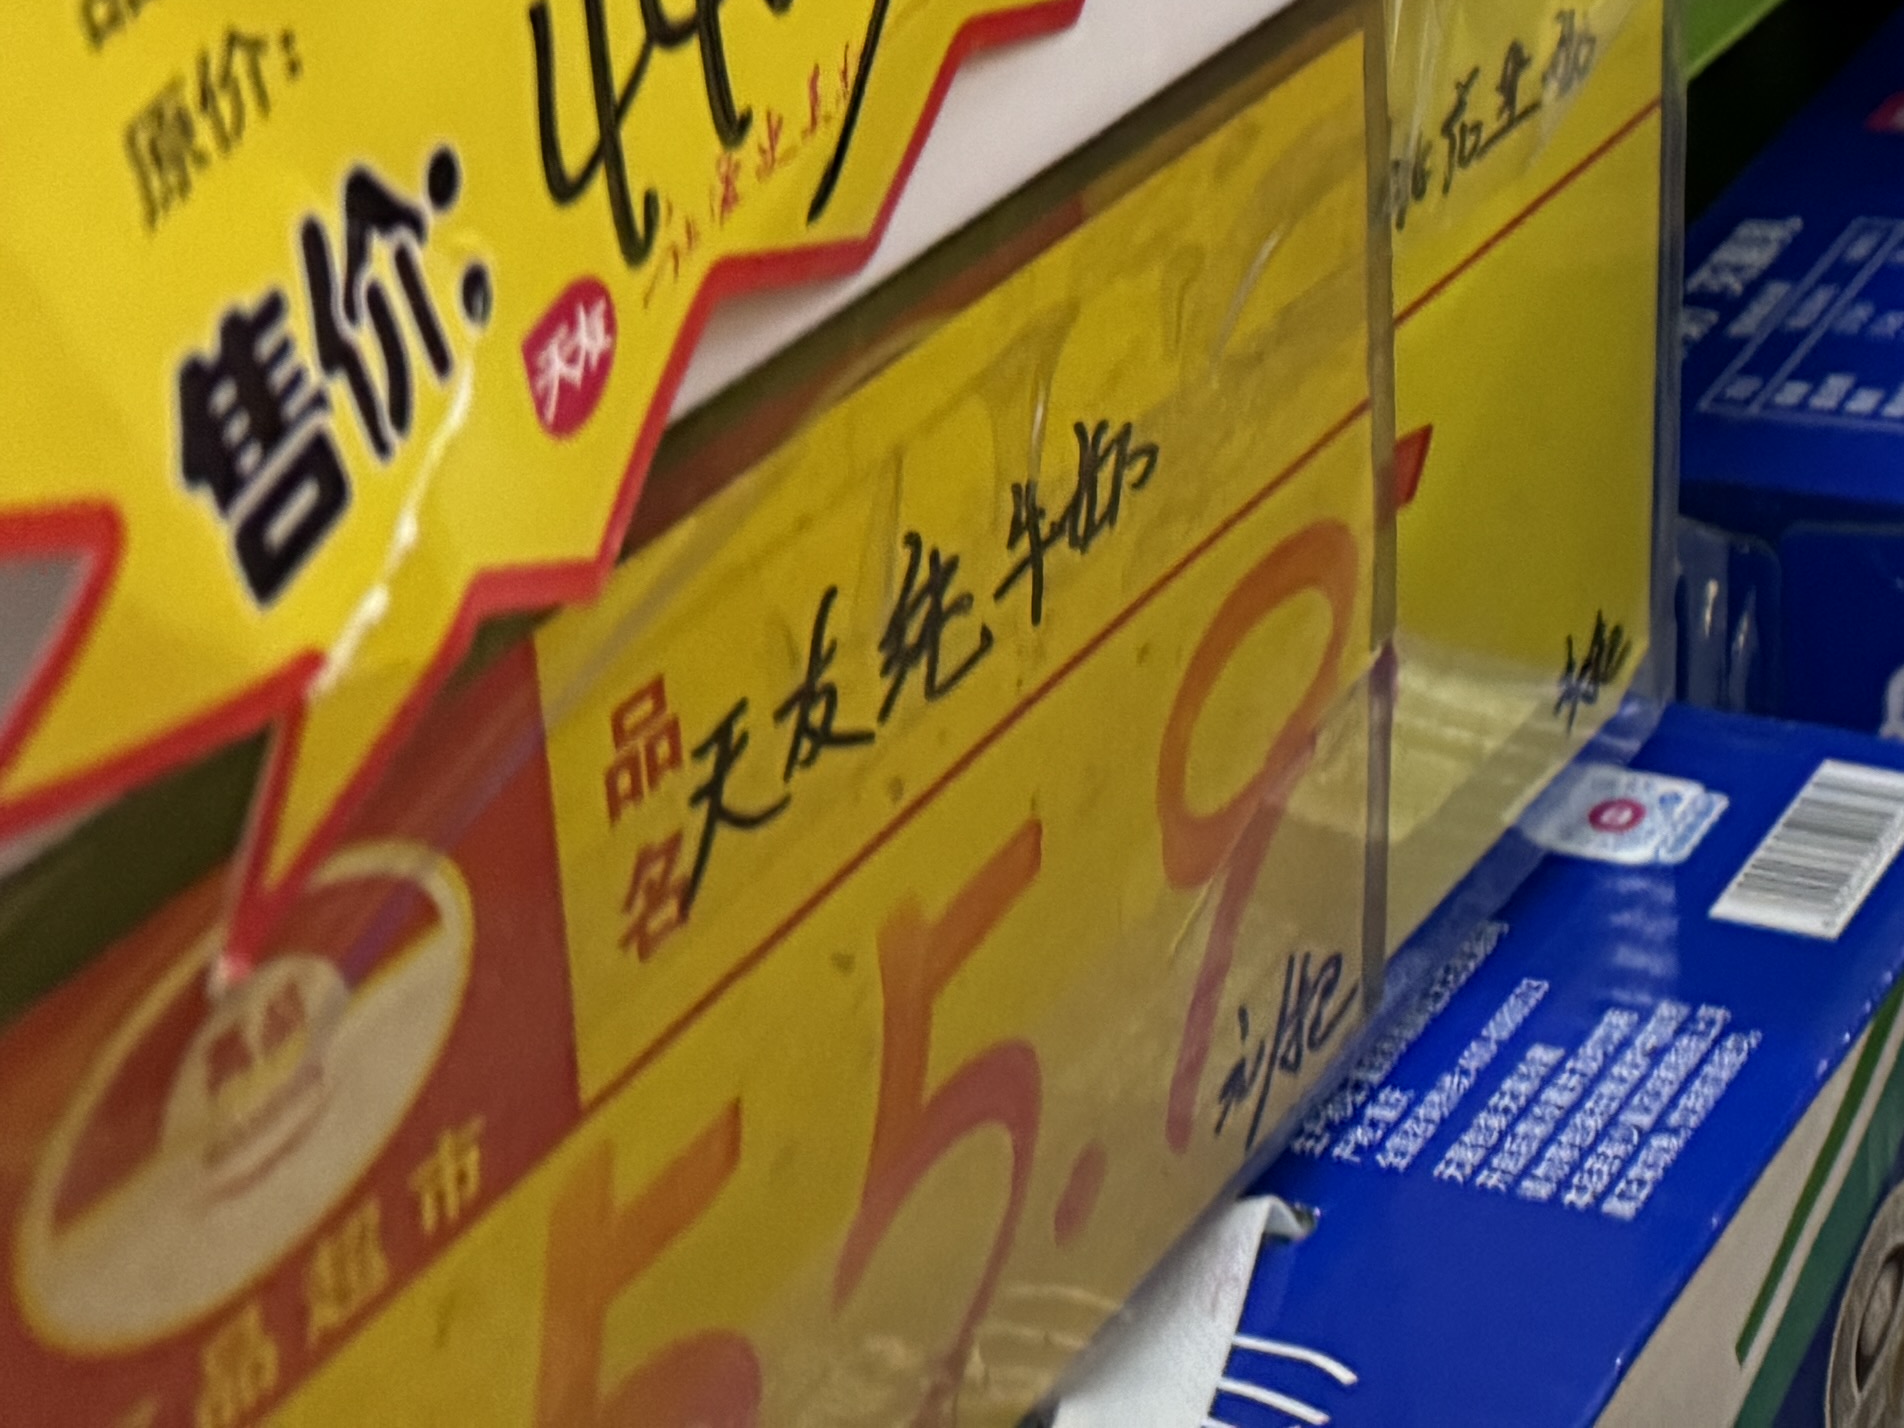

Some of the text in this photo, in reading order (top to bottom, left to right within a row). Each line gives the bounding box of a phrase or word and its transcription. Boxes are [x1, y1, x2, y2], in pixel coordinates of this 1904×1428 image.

[124, 24, 303, 236] 原价:
[176, 142, 496, 606] 售价:
[526, 297, 611, 427] 天友
[688, 417, 1162, 924] 天友纯牛奶
[604, 672, 690, 964] 品名
